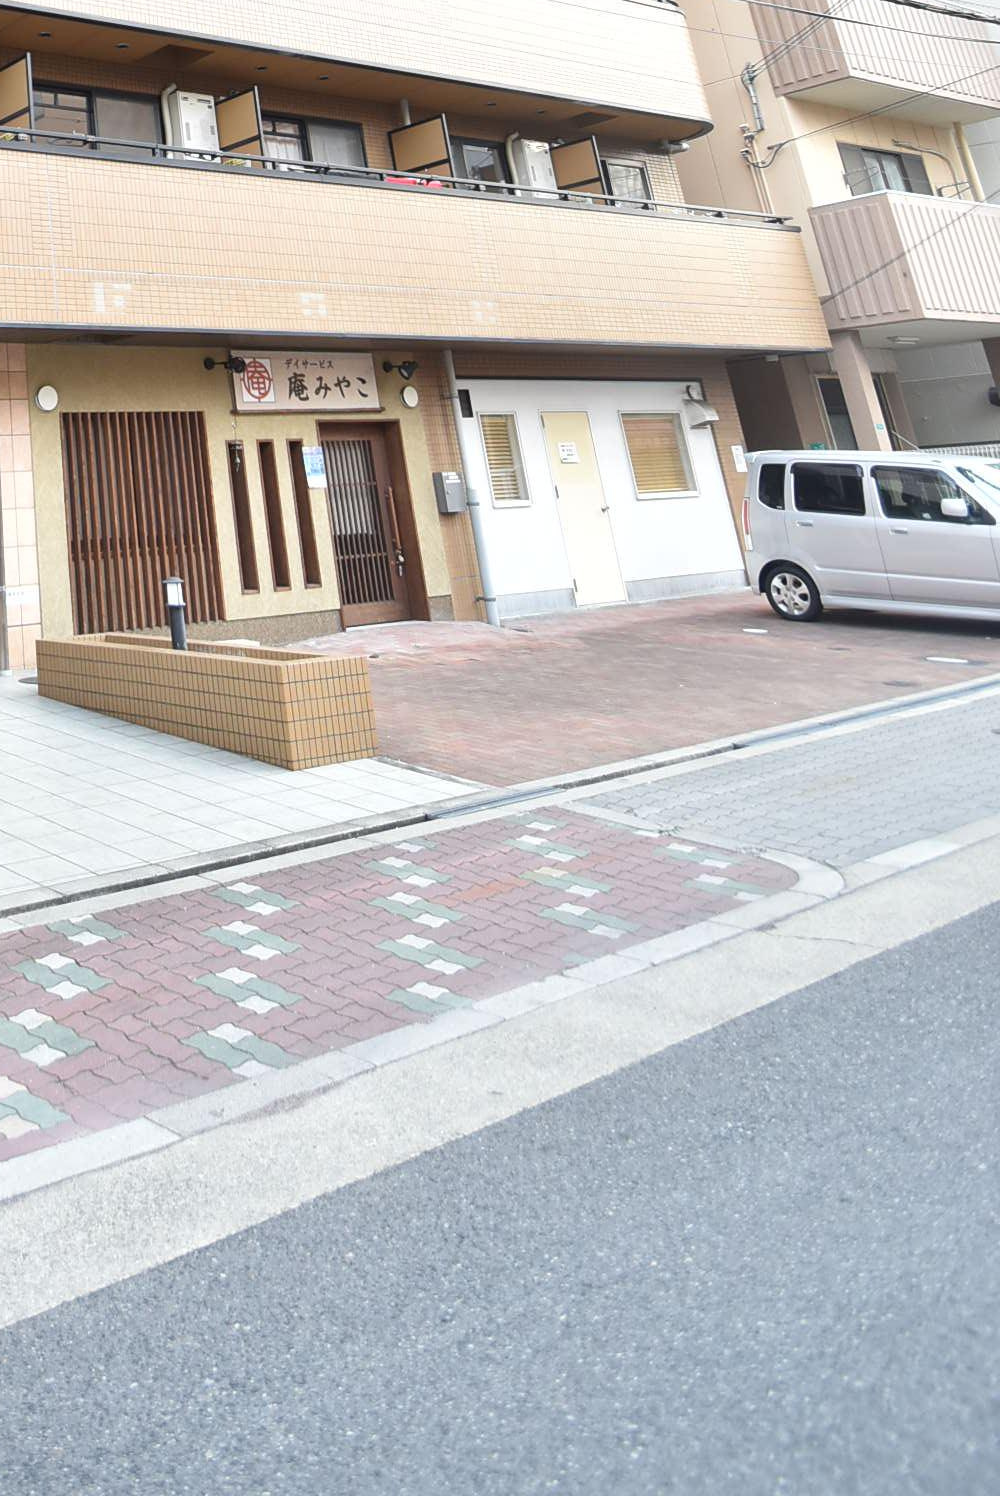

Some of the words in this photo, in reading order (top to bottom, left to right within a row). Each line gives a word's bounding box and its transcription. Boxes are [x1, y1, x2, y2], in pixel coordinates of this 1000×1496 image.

[284, 359, 335, 370] デイサービス
[287, 372, 369, 402] 庵みやこ
